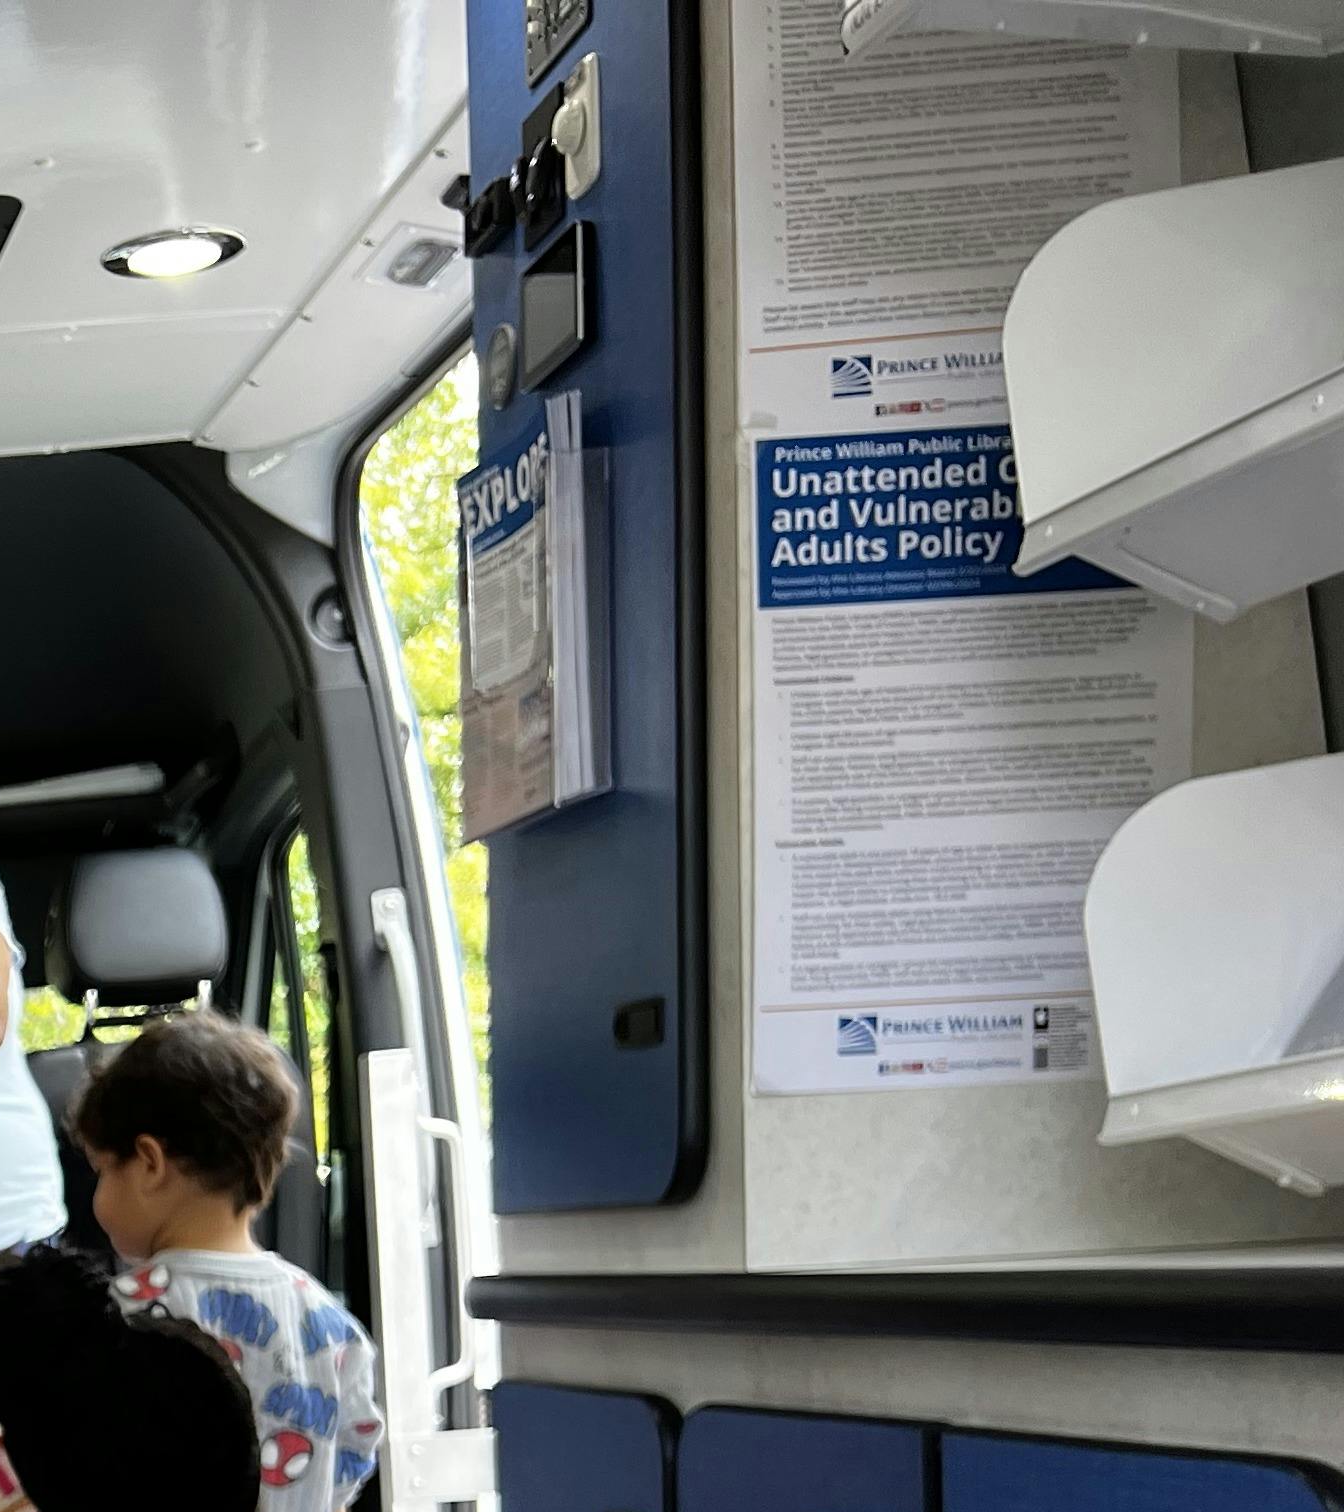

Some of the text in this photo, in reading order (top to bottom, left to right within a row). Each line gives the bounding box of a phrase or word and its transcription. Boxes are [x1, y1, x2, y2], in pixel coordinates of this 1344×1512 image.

[876, 357, 939, 376] PRINCE
[774, 443, 833, 464] Prince
[834, 440, 905, 459] William
[907, 434, 963, 455] Public
[771, 455, 988, 499] Unattended
[771, 498, 840, 534] and
[770, 525, 1005, 569] Adults Policy
[881, 1013, 1025, 1038] PRINCE WILLIAM
